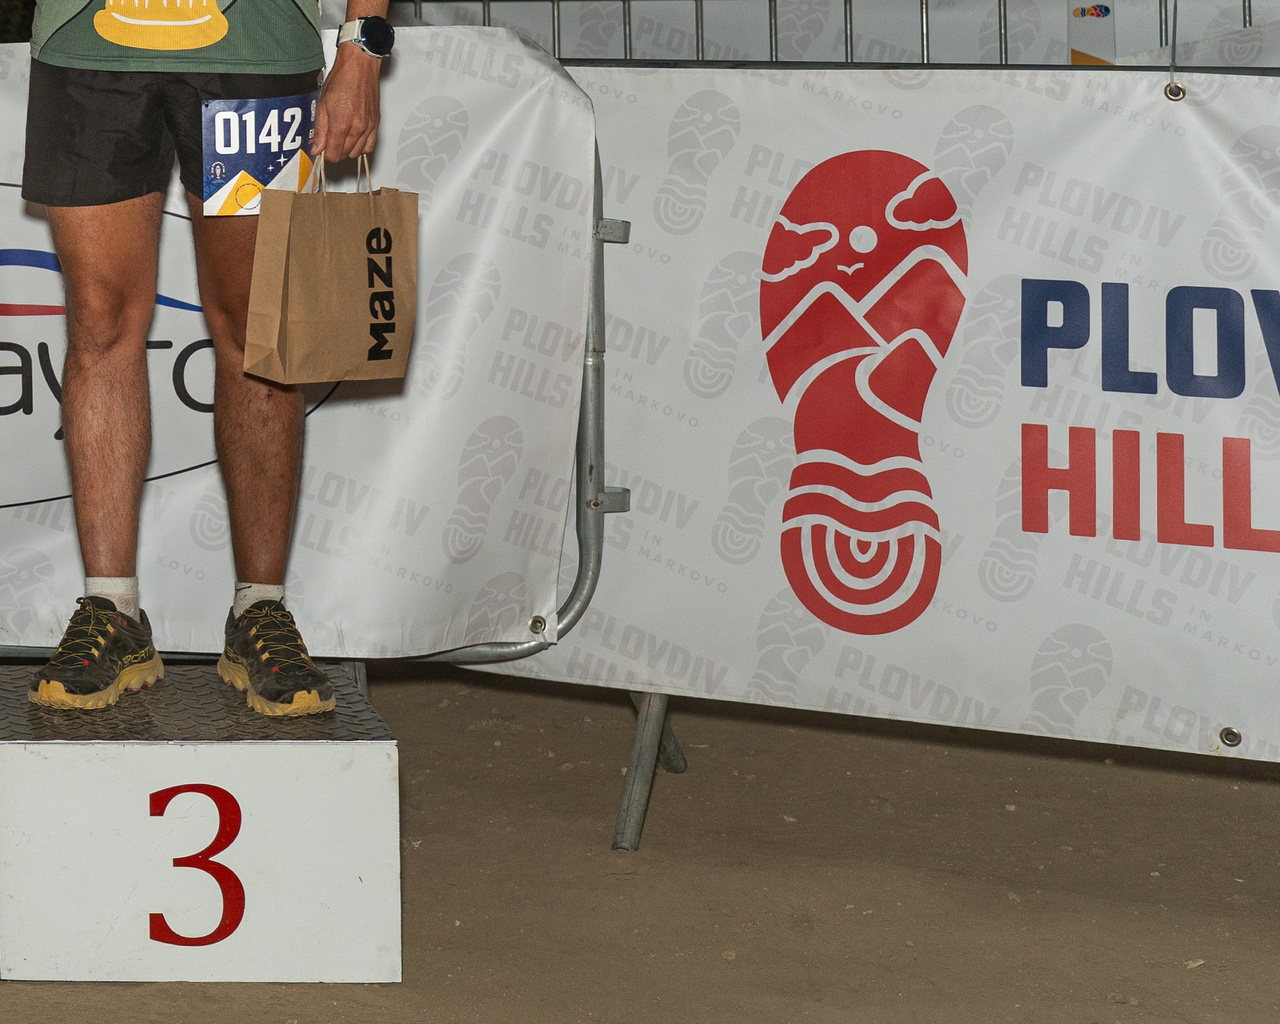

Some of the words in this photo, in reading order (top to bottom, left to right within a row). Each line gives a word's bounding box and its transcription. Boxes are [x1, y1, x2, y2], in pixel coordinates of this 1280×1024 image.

[801, 79, 904, 121] MARKOVO
[1081, 95, 1186, 138] MARKOVO
[215, 107, 302, 155] 0142
[1012, 161, 1186, 249] PLOVDIV
[996, 205, 1109, 275] HILLS
[1120, 251, 1143, 267] IN
[487, 350, 573, 409] HILLS
[609, 380, 701, 429] MARKOVO
[637, 544, 729, 595] MARKOVO
[1062, 553, 1178, 627] HILLS
[1189, 605, 1213, 623] IN
[578, 607, 729, 696] PLOVDIV
[148, 783, 246, 947] 3
